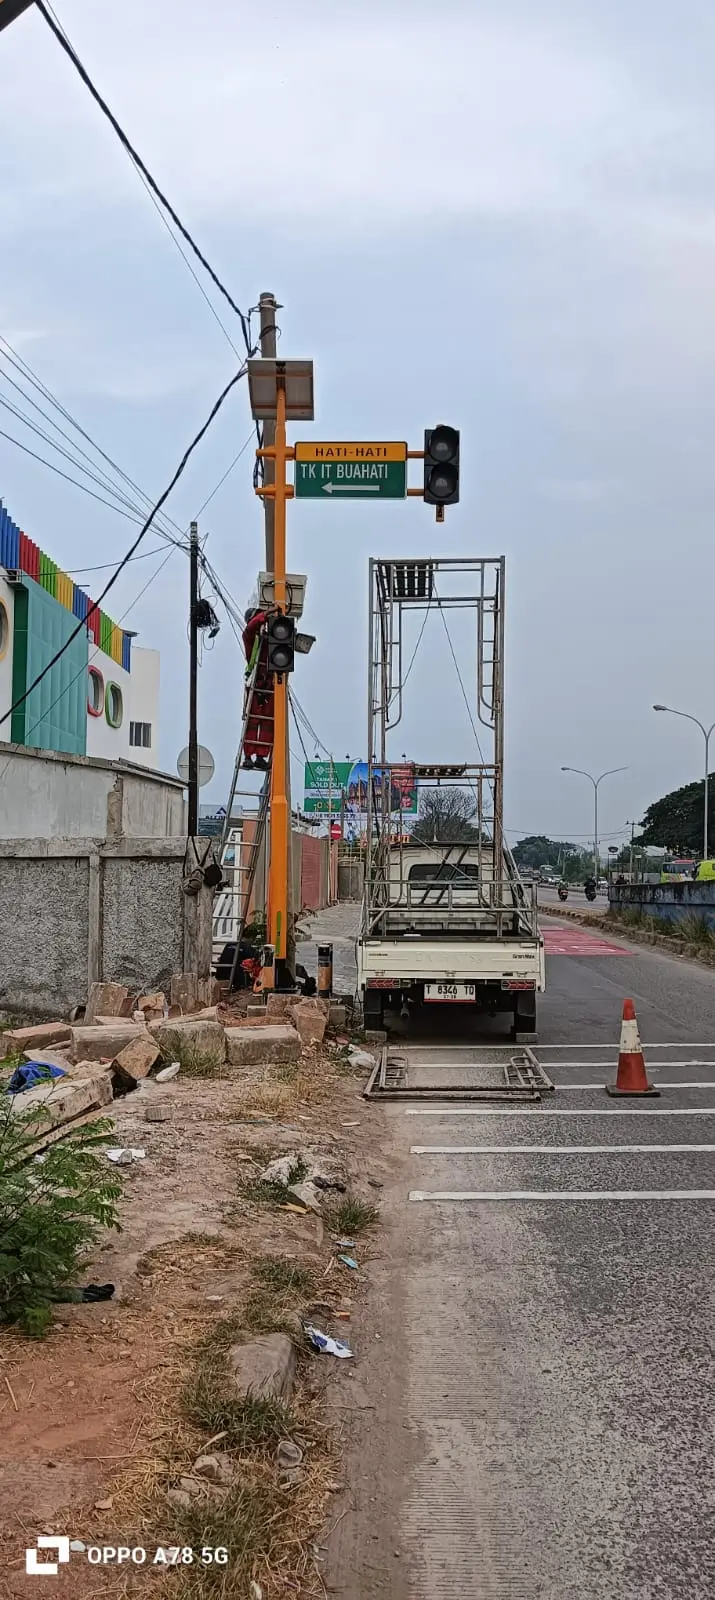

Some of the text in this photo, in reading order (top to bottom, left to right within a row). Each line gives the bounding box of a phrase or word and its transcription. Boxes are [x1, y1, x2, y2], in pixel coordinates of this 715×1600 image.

[315, 447, 387, 456] HATI-HATI
[300, 463, 388, 479] TK IT BUAHATI
[426, 984, 431, 994] T
[438, 985, 458, 995] 8346
